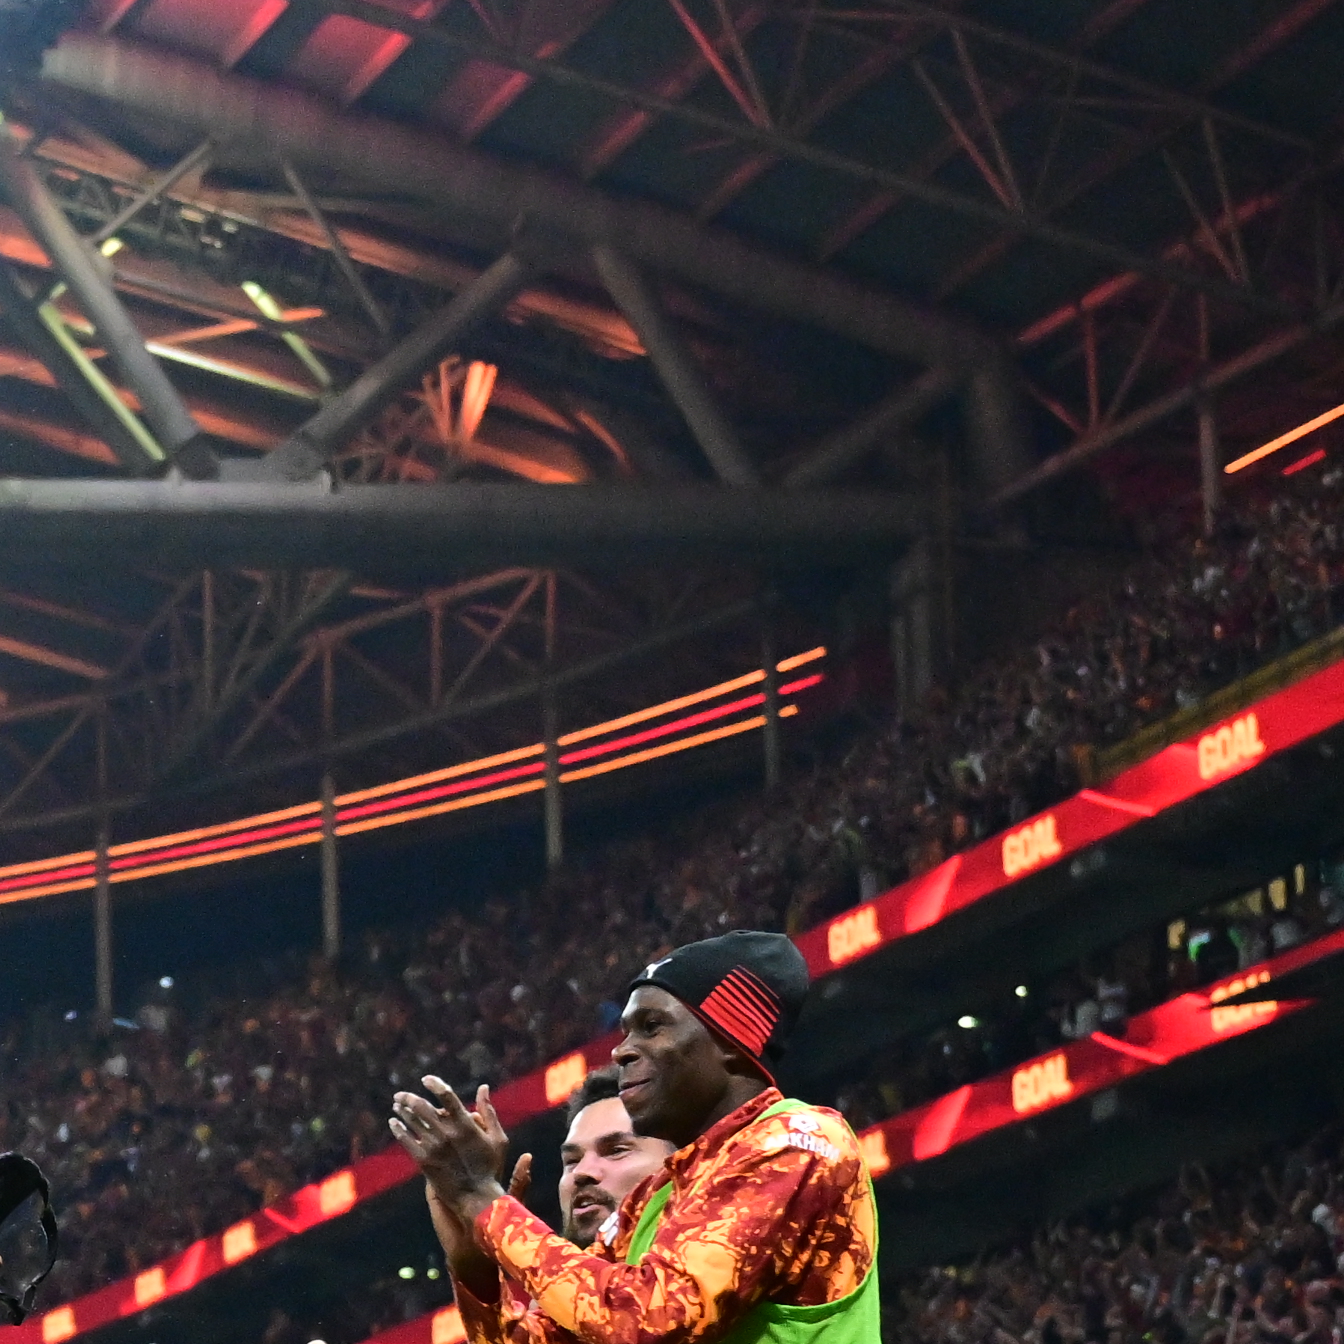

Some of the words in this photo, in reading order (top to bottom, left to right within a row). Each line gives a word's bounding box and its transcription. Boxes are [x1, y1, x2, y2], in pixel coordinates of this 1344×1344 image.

[1197, 713, 1265, 780] GOAL
[1002, 815, 1062, 877] GOAL
[1012, 1055, 1073, 1114] GOAL
